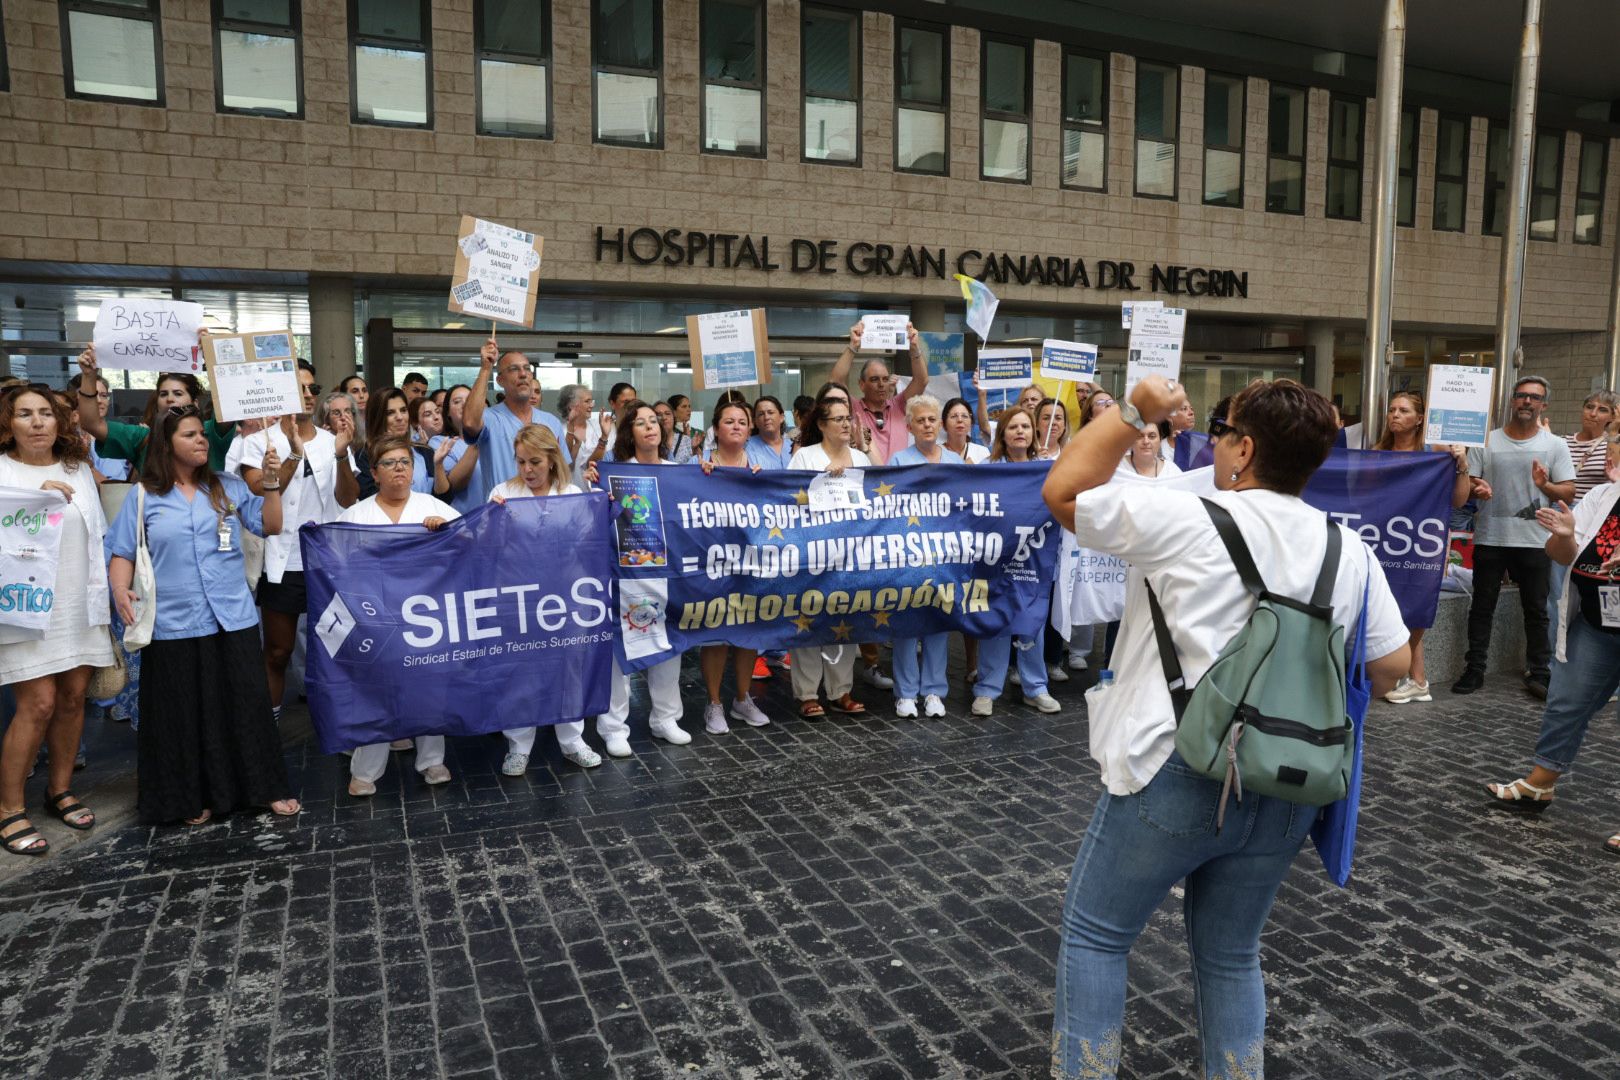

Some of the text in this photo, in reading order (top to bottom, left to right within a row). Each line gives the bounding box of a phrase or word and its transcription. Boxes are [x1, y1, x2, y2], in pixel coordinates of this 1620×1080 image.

[487, 248, 519, 262] ANALIZO TU
[596, 226, 779, 271] HOSPITAL
[791, 238, 838, 274] DE
[846, 241, 946, 280] GRAN
[957, 250, 1090, 288] CANARIA
[1150, 263, 1248, 298] NEGRIN
[490, 260, 512, 270] SANGRE
[482, 293, 510, 305] HAGO TUS
[111, 305, 181, 331] BASTA
[138, 332, 159, 342] DE
[246, 388, 265, 396] APLICO
[238, 396, 276, 407] TRATAMIENTO
[677, 498, 761, 529] TÉCNICO
[863, 493, 951, 520] SANITARIO
[955, 497, 968, 511] +
[972, 492, 1005, 517] U.E.
[682, 531, 1004, 580] = GRADO UNIVERSITARIO
[1403, 560, 1442, 572] Sanitaris
[0, 583, 54, 613] STICO
[679, 578, 955, 630] HOMOLOGACIÓN
[361, 601, 377, 616] S
[401, 577, 613, 649] SIETeS
[358, 638, 374, 653] S
[403, 651, 449, 667] Sindicat
[452, 647, 487, 662] Estatal
[489, 644, 503, 656] de
[505, 641, 547, 653] Tècnics
[550, 633, 599, 650] Superiors
